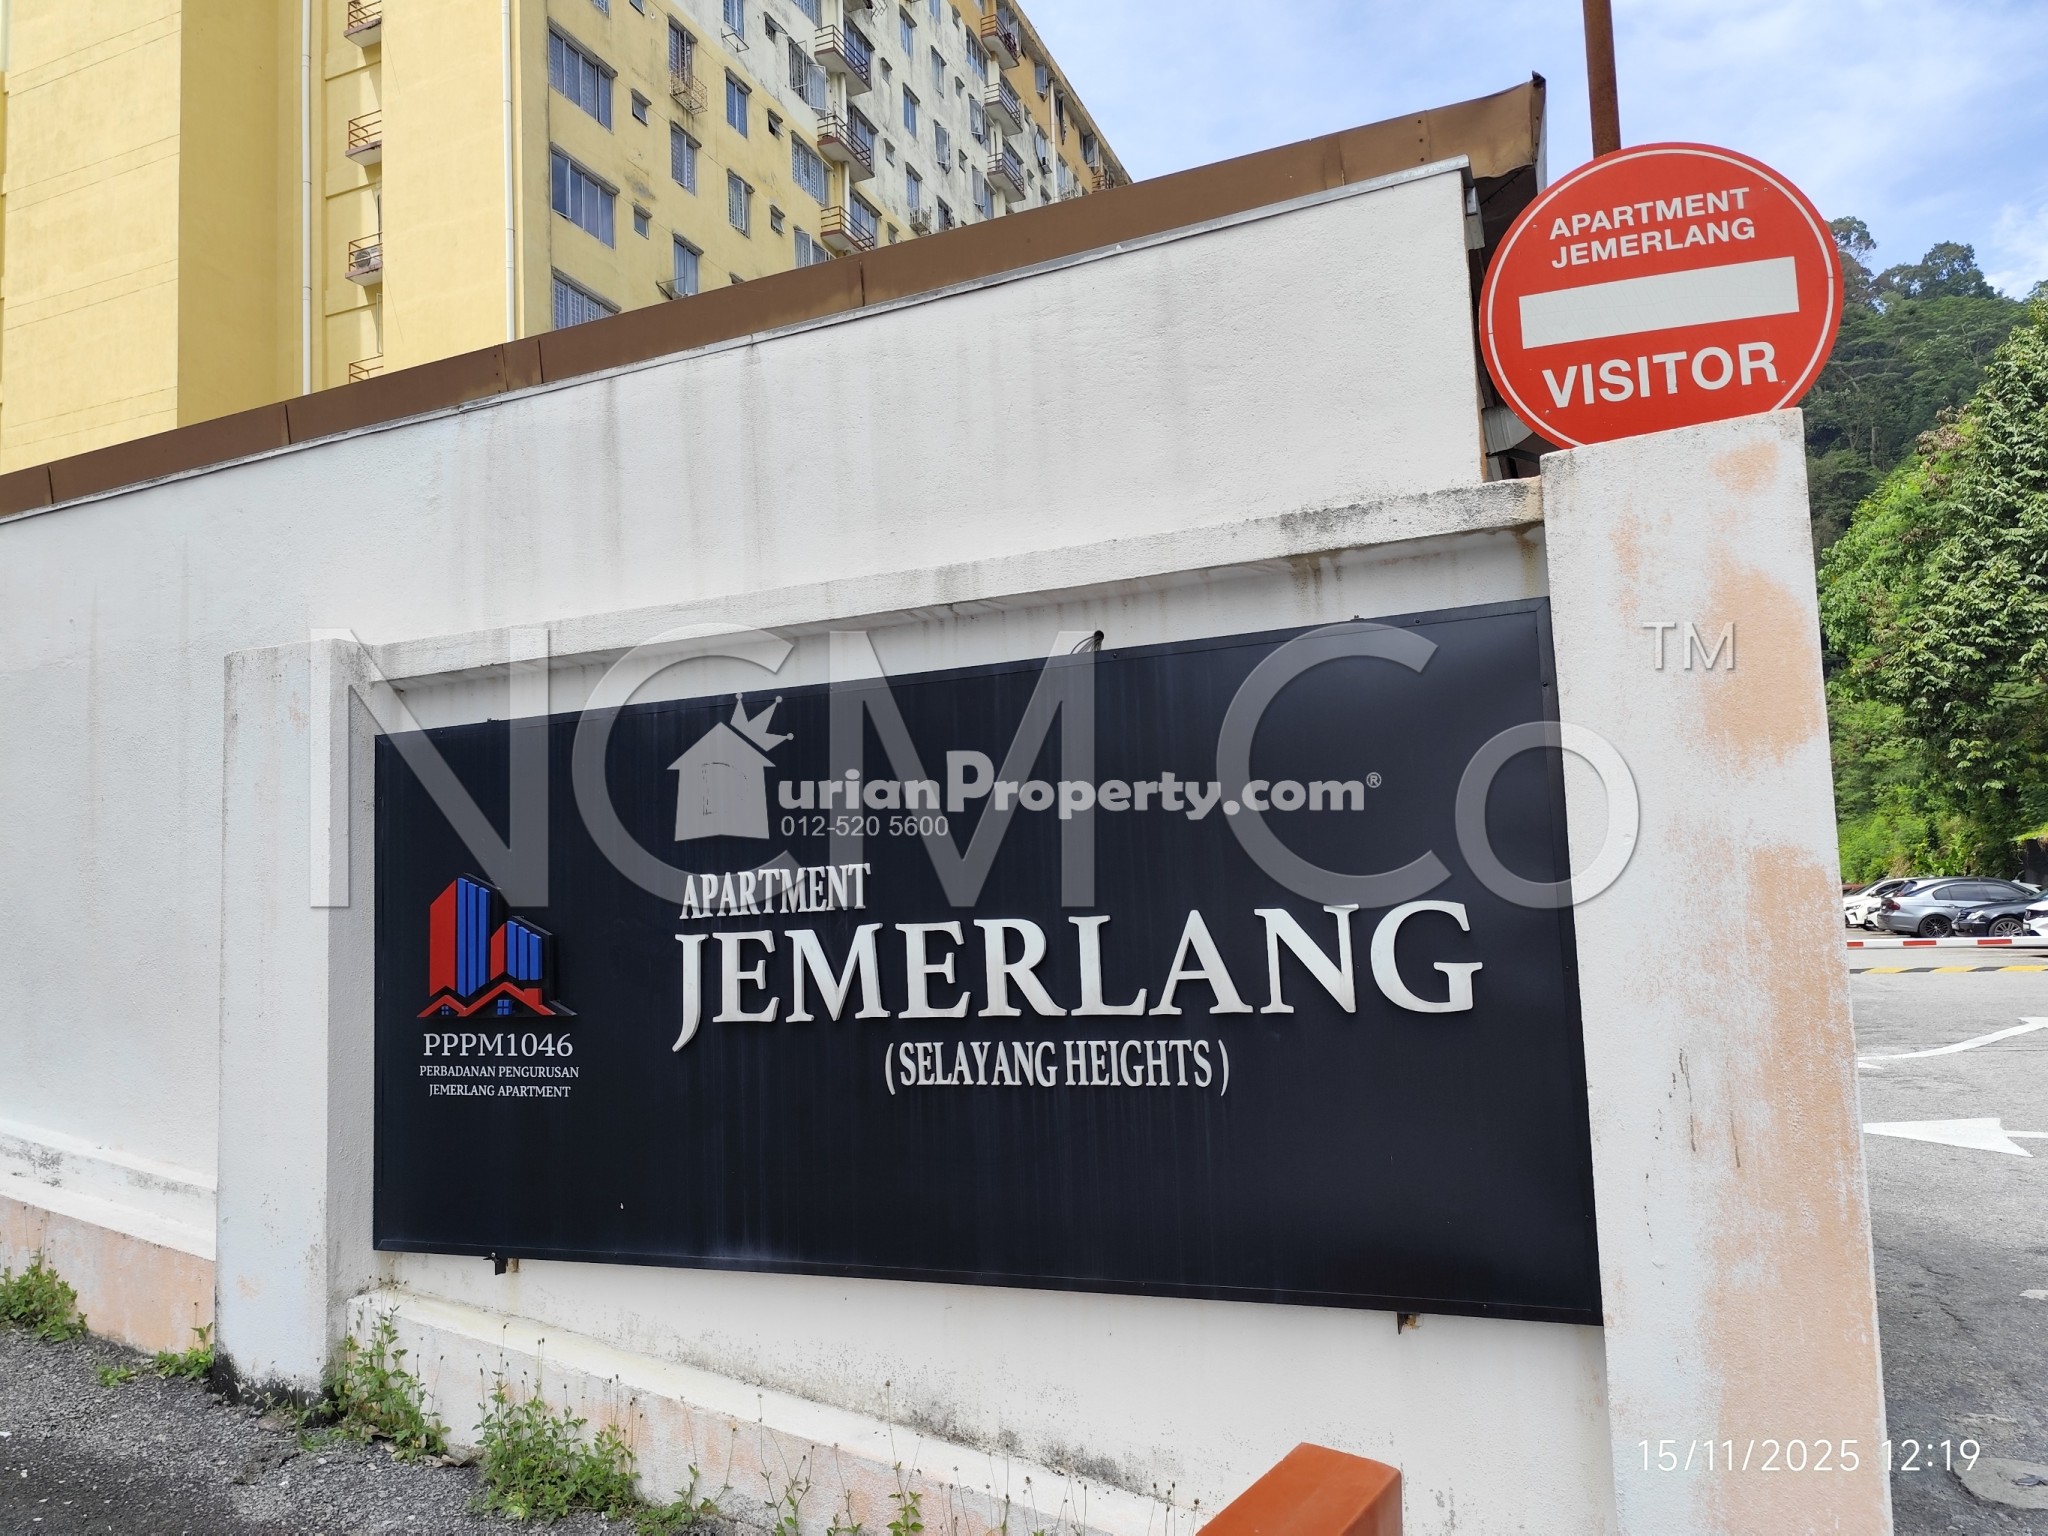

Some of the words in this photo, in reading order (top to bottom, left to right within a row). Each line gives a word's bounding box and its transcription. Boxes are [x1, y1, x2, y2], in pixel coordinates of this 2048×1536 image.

[1550, 188, 1750, 240] APARTMENT
[1551, 218, 1756, 268] JEMERLANG
[1542, 341, 1779, 409] VISITOR
[679, 863, 871, 919] APARTMENT
[672, 900, 1484, 1052] JEMERLANG
[423, 1033, 574, 1057] PPPM1046
[885, 1040, 1058, 1095] (SELAYANG
[419, 1065, 496, 1077] PERBADANAN
[498, 1066, 580, 1078] PENGURUSAN
[429, 1084, 495, 1097] JEMERLANG
[497, 1085, 571, 1098] APARTMENT
